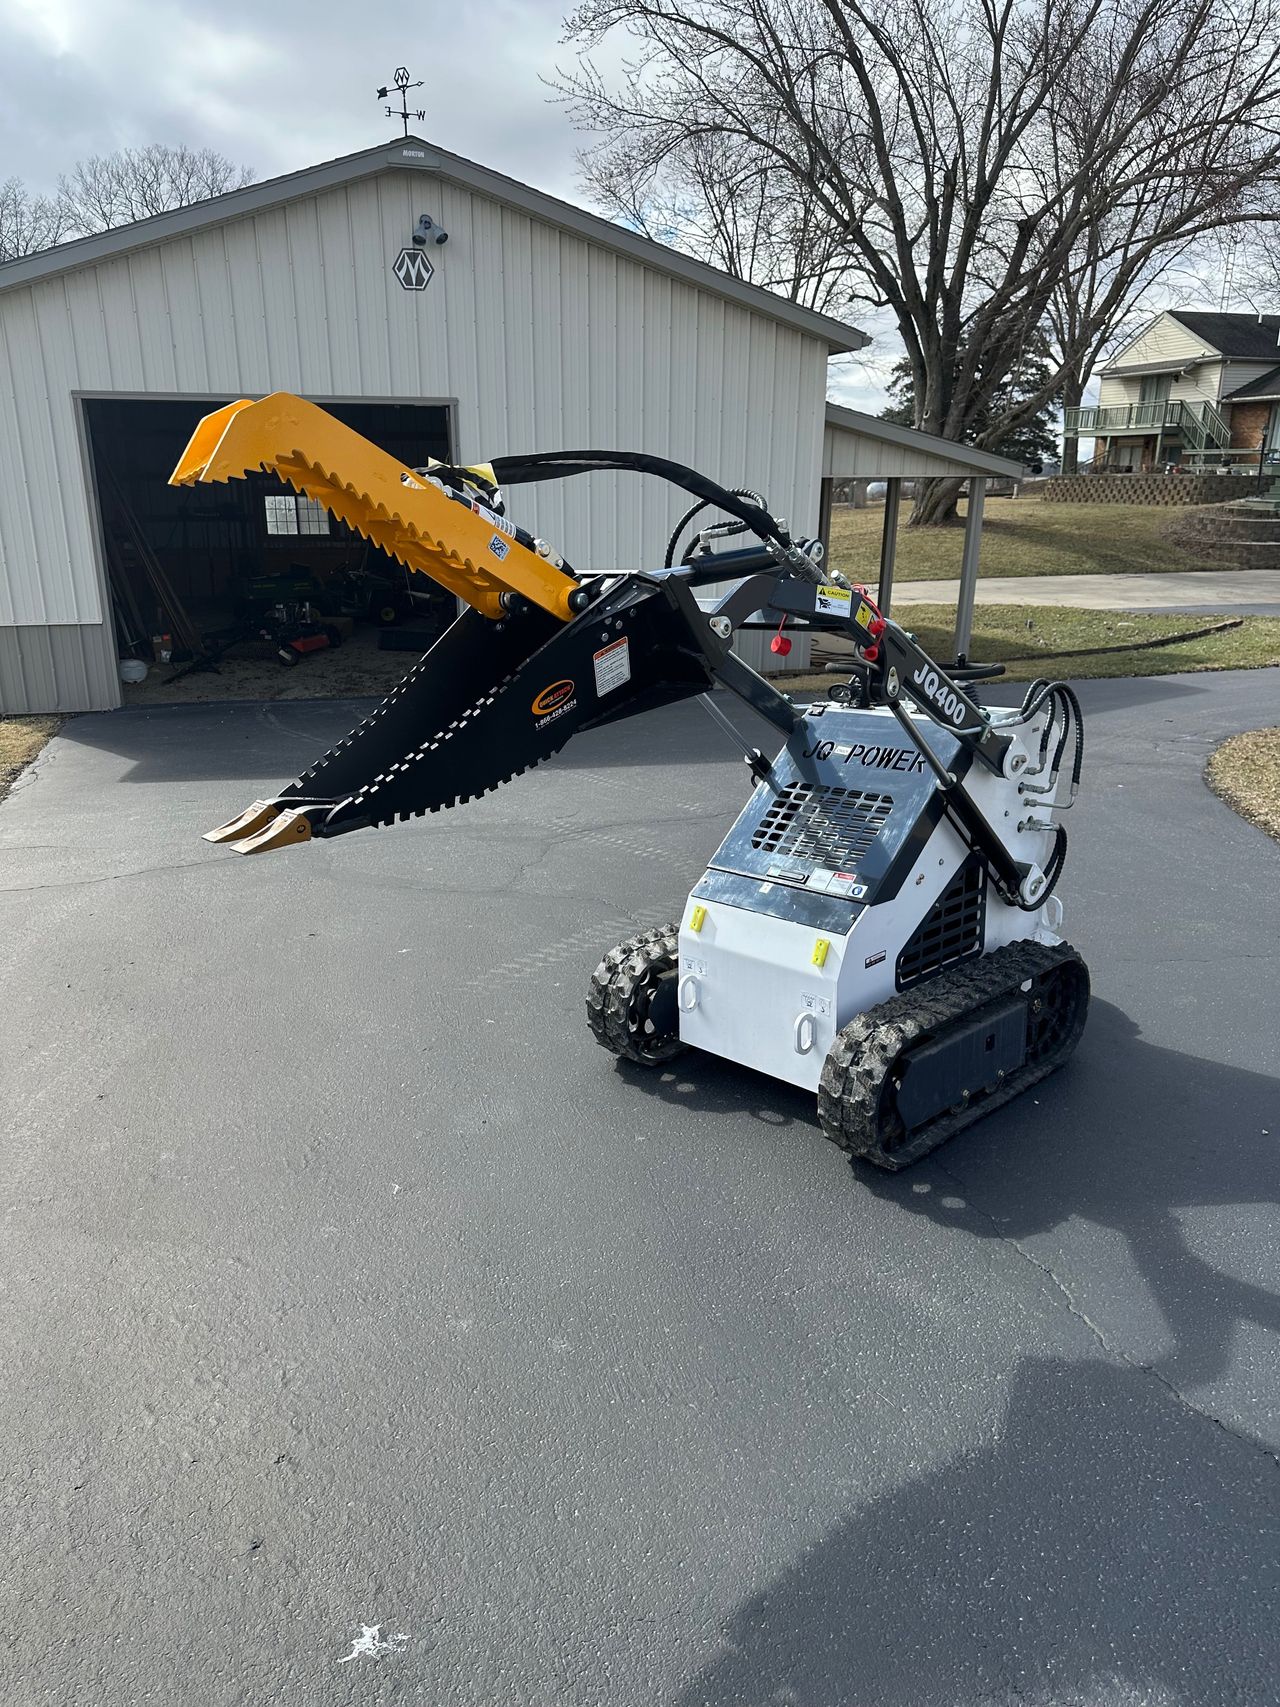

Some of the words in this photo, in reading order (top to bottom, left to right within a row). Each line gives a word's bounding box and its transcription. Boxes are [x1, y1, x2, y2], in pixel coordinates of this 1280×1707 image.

[402, 149, 425, 158] MORTON
[827, 590, 850, 598] CAUTION
[914, 663, 966, 725] JQ400
[802, 740, 835, 761] JQ
